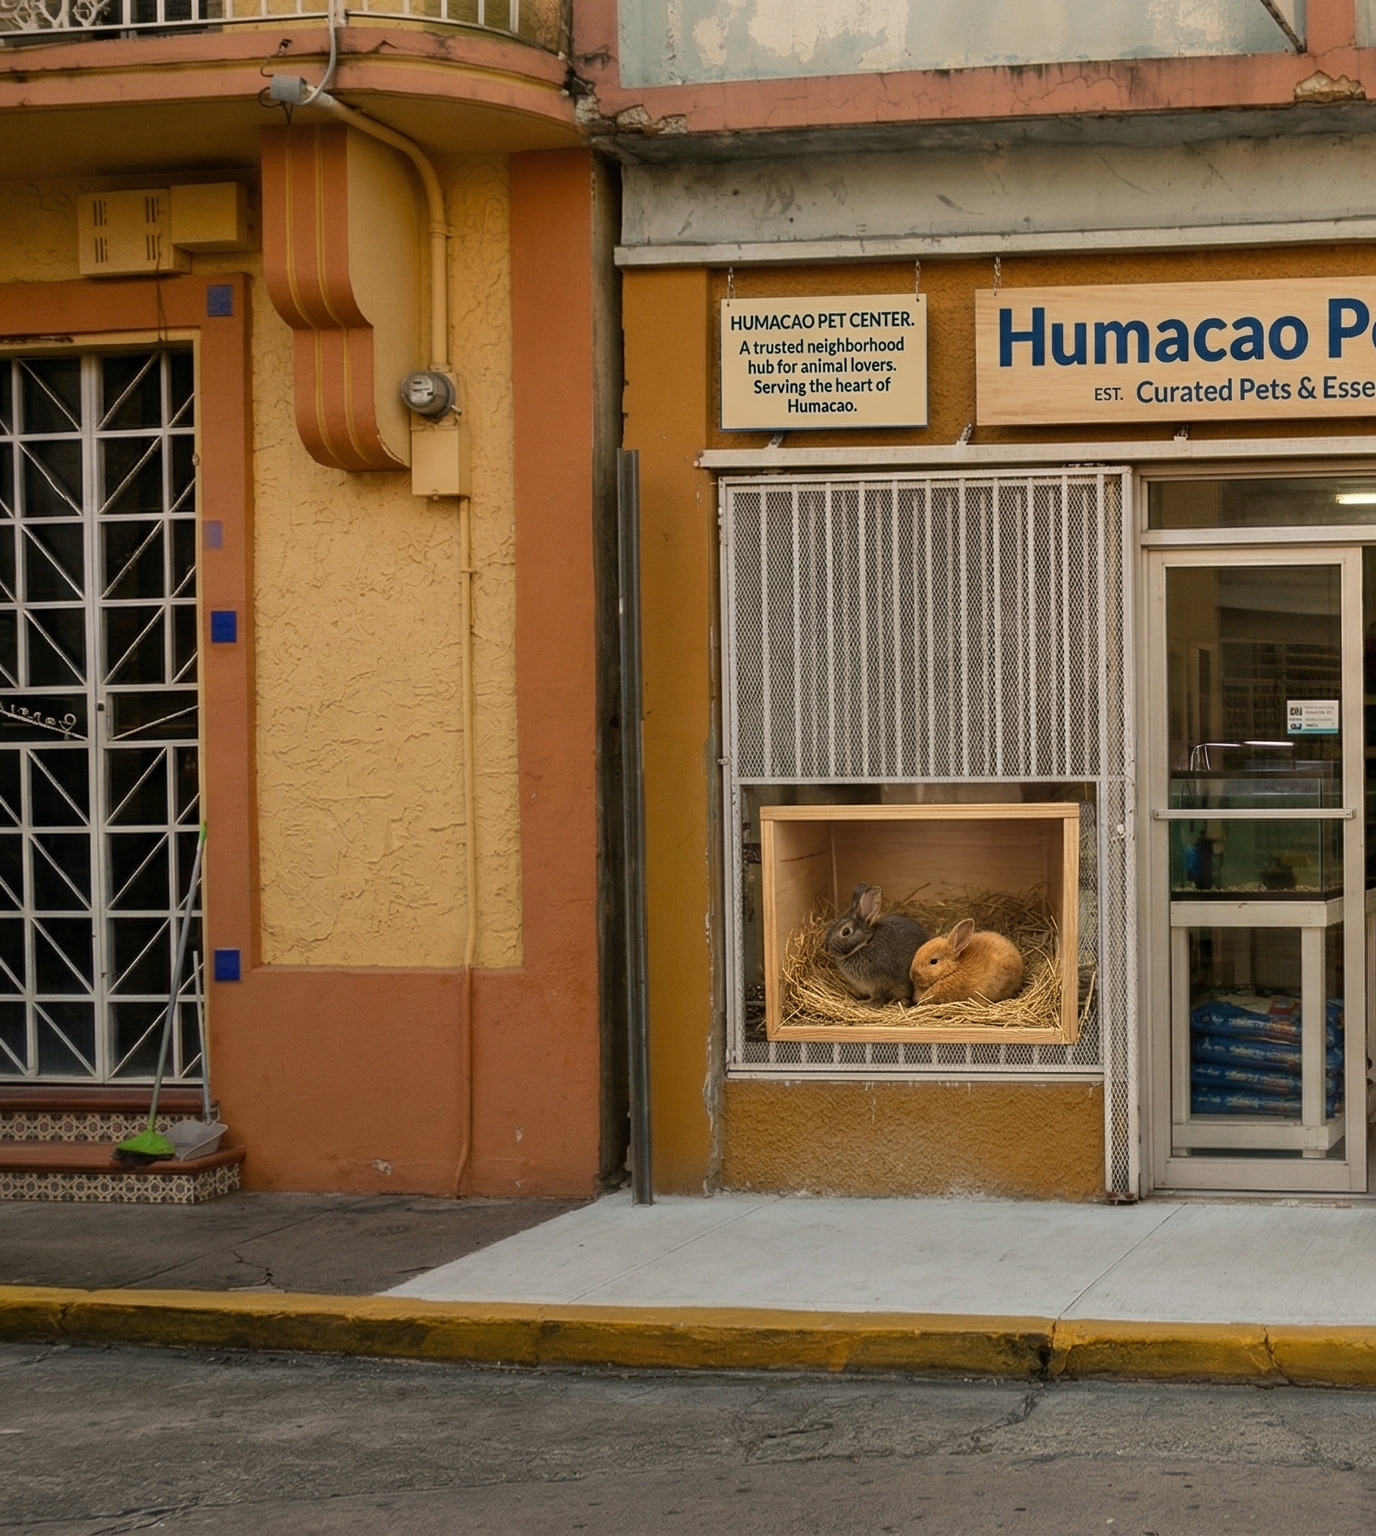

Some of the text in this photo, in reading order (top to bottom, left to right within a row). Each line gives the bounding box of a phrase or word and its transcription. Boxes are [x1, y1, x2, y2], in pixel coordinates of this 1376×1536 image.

[730, 311, 915, 330] HUMACAO PET CENTER.
[739, 336, 905, 356] A trusted neighborhood
[999, 306, 1309, 367] Humacao
[748, 357, 897, 375] hub for animal lovers.
[753, 376, 892, 396] Serving the heart of
[1094, 387, 1124, 402] EST.
[1136, 377, 1233, 404] Curated
[1239, 377, 1292, 401] Pets
[1297, 375, 1318, 399] &
[787, 398, 858, 414] Humacao.
